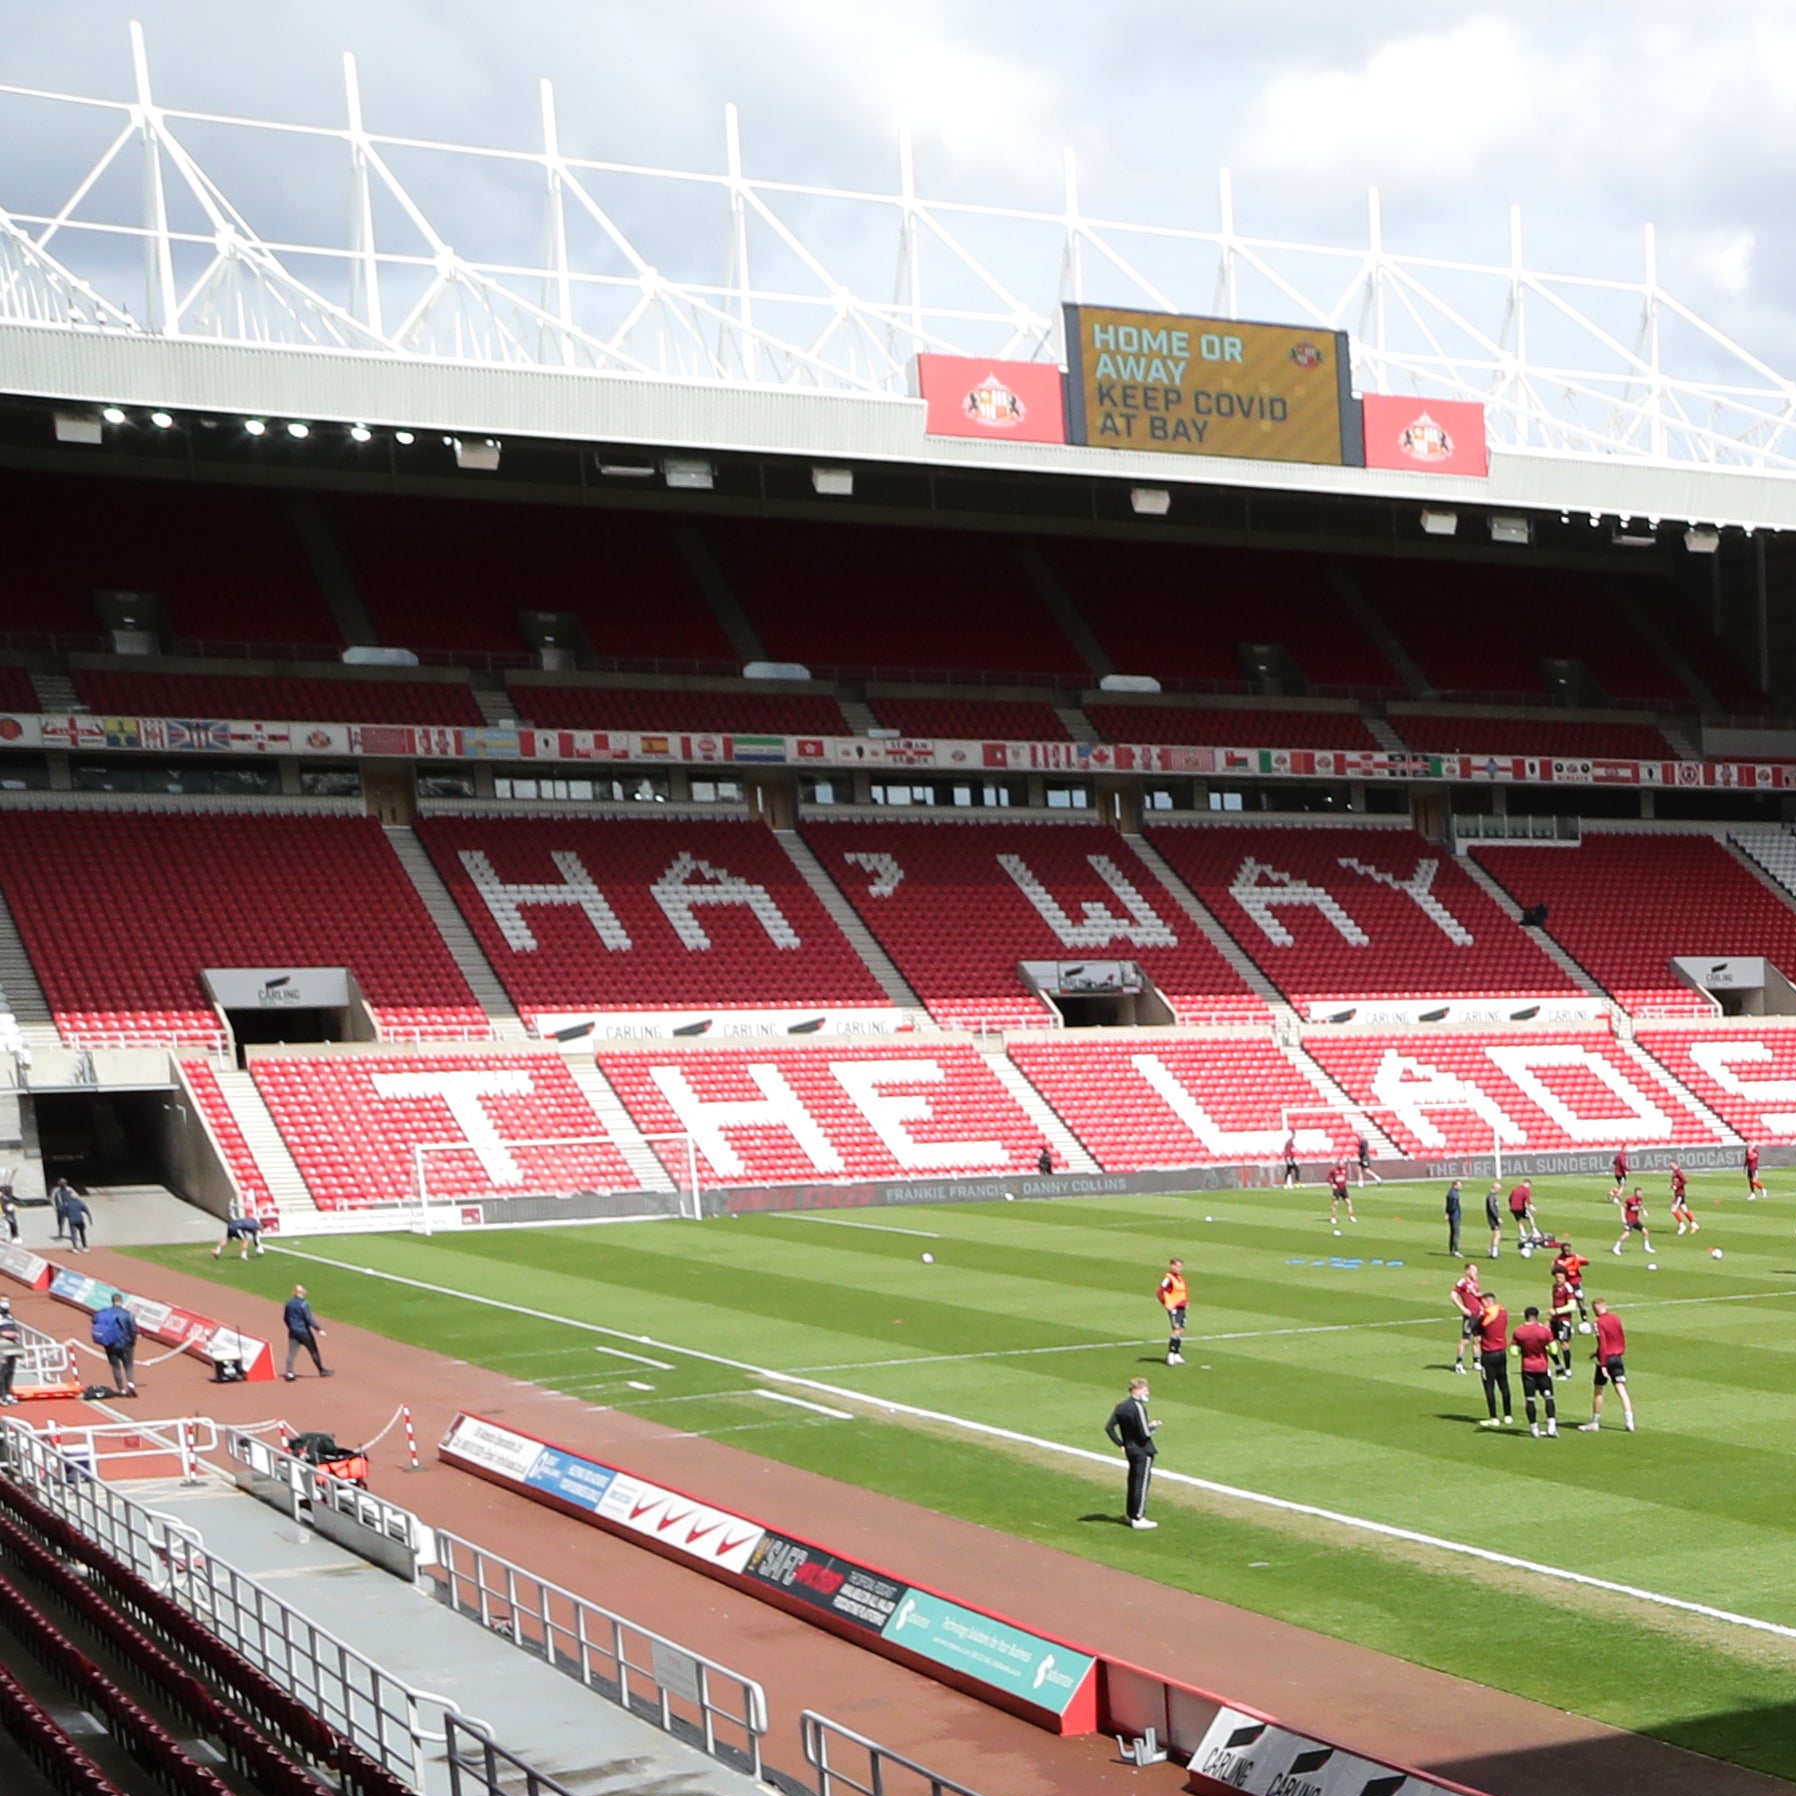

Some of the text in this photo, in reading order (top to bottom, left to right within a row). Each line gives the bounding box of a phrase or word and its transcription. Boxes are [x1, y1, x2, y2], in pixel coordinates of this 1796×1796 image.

[1093, 325, 1243, 364] HOME OR
[1095, 356, 1186, 386] AWAY
[1098, 382, 1288, 423] KEEP COVID
[1100, 415, 1209, 444] AT BAY
[997, 854, 1475, 948] WAY
[258, 989, 300, 1001] CARLING
[836, 1022, 888, 1035] CARLING
[1366, 1012, 1409, 1024] CARLING
[1459, 1011, 1501, 1023] CARLING
[606, 1026, 661, 1040] CARLING
[723, 1024, 778, 1038] CARLING
[371, 1059, 1010, 1187] THE
[1427, 1162, 1458, 1177] THE
[1675, 1150, 1745, 1168] PODCAST
[886, 1186, 945, 1201] FRANKIE
[948, 1183, 1007, 1199] FRANCIS
[1022, 1180, 1066, 1195] DANNY
[1069, 1178, 1127, 1194] COLLINS
[1203, 1747, 1252, 1788] CARLING
